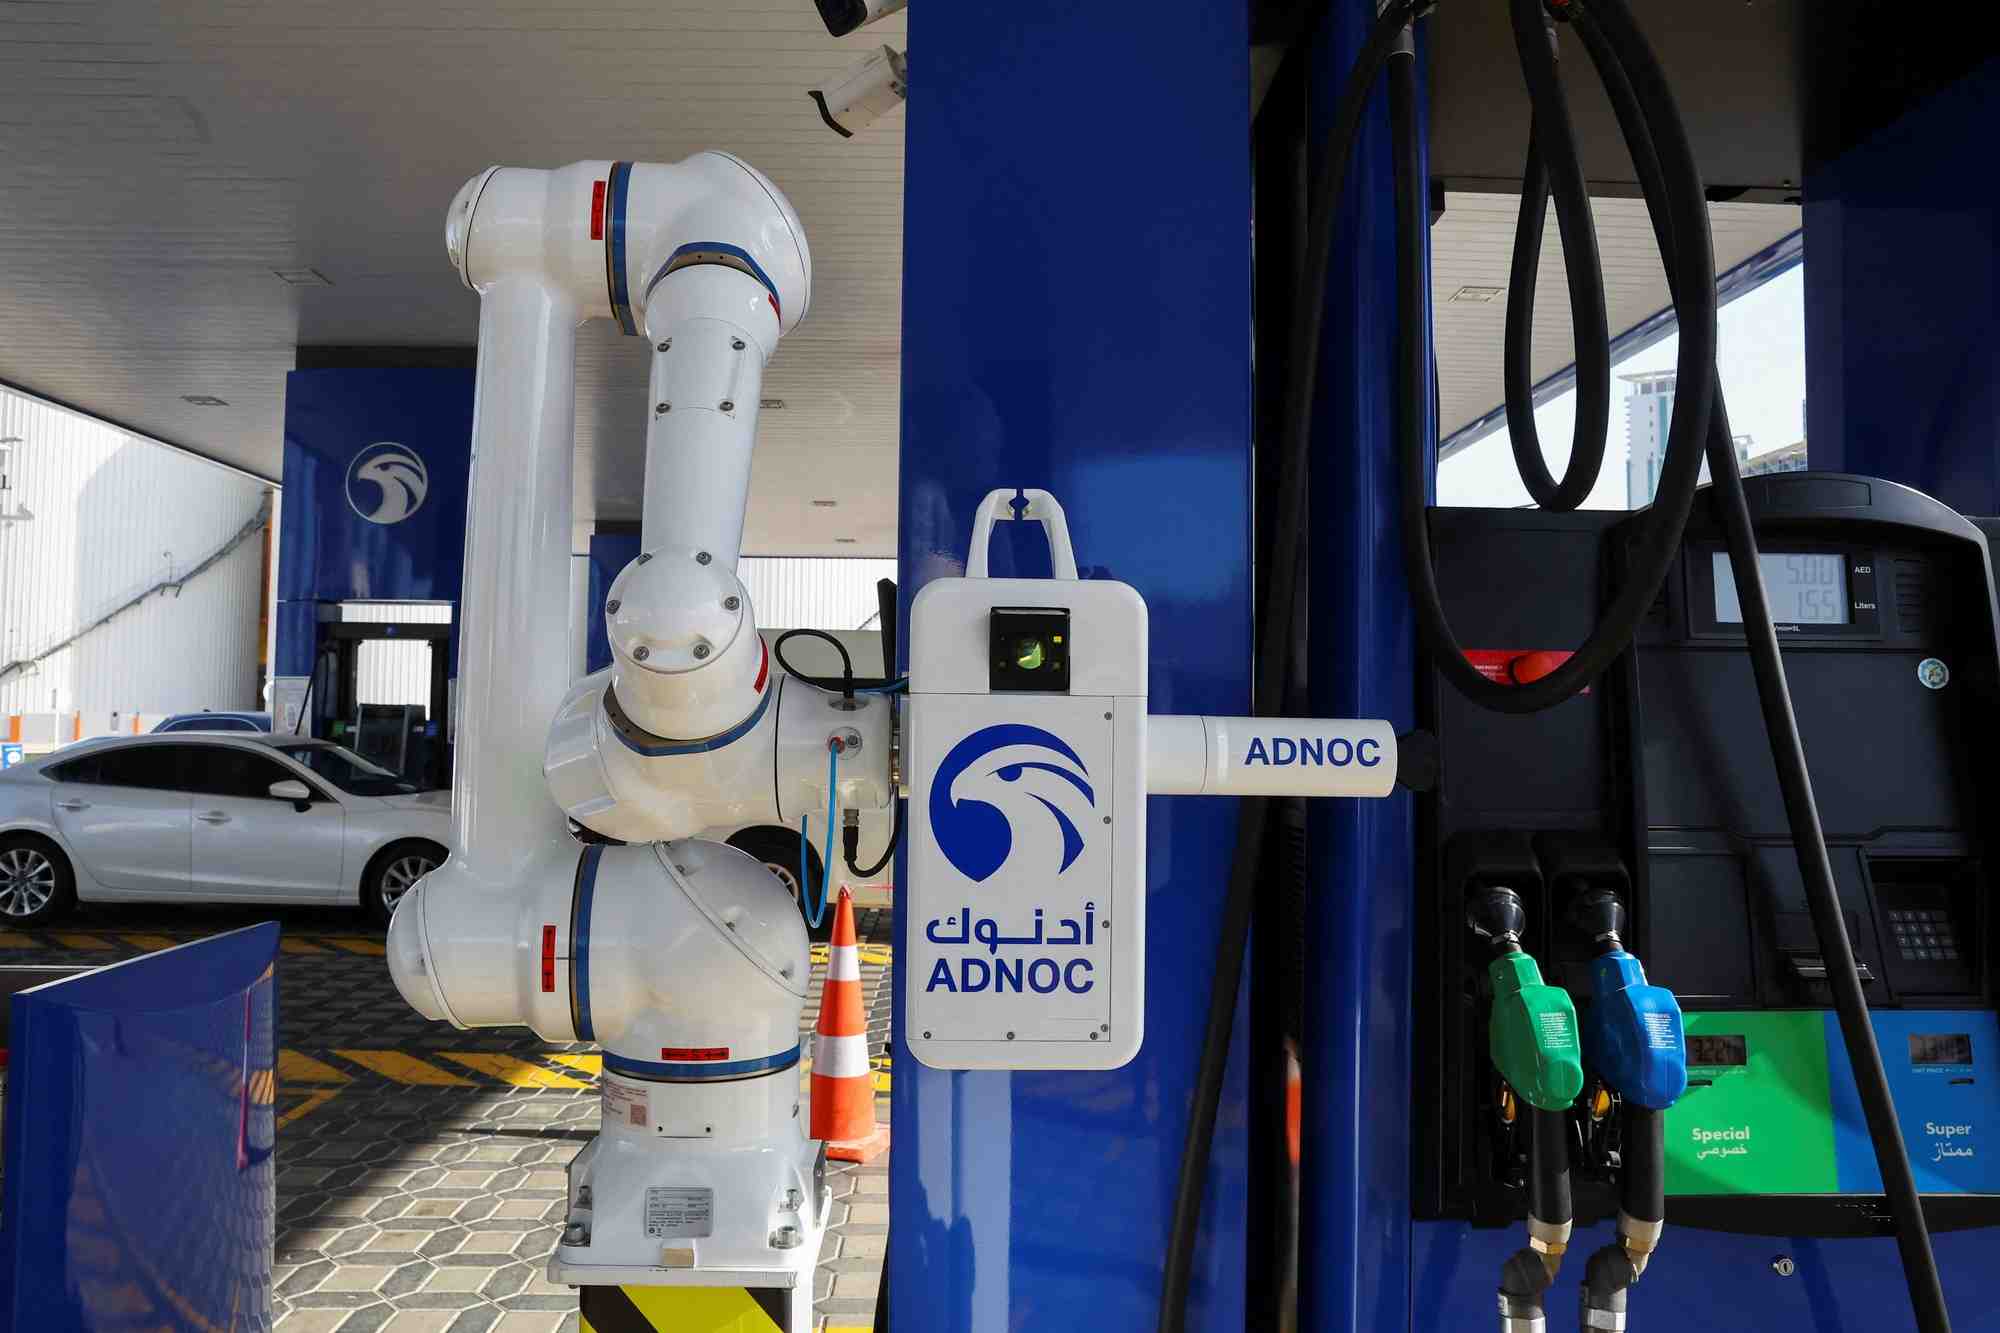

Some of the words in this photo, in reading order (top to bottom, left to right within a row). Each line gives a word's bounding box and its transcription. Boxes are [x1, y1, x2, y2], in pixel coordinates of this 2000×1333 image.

[1854, 566, 1872, 574] AED
[1246, 736, 1380, 767] ADNOC
[926, 902, 1094, 955] أدنوك
[926, 958, 1094, 993] ADNOC
[1691, 1125, 1751, 1144] Special
[1925, 1121, 1973, 1139] Super
[1696, 1144, 1749, 1161] خصومي
[1931, 1141, 1975, 1163] ممتاز
